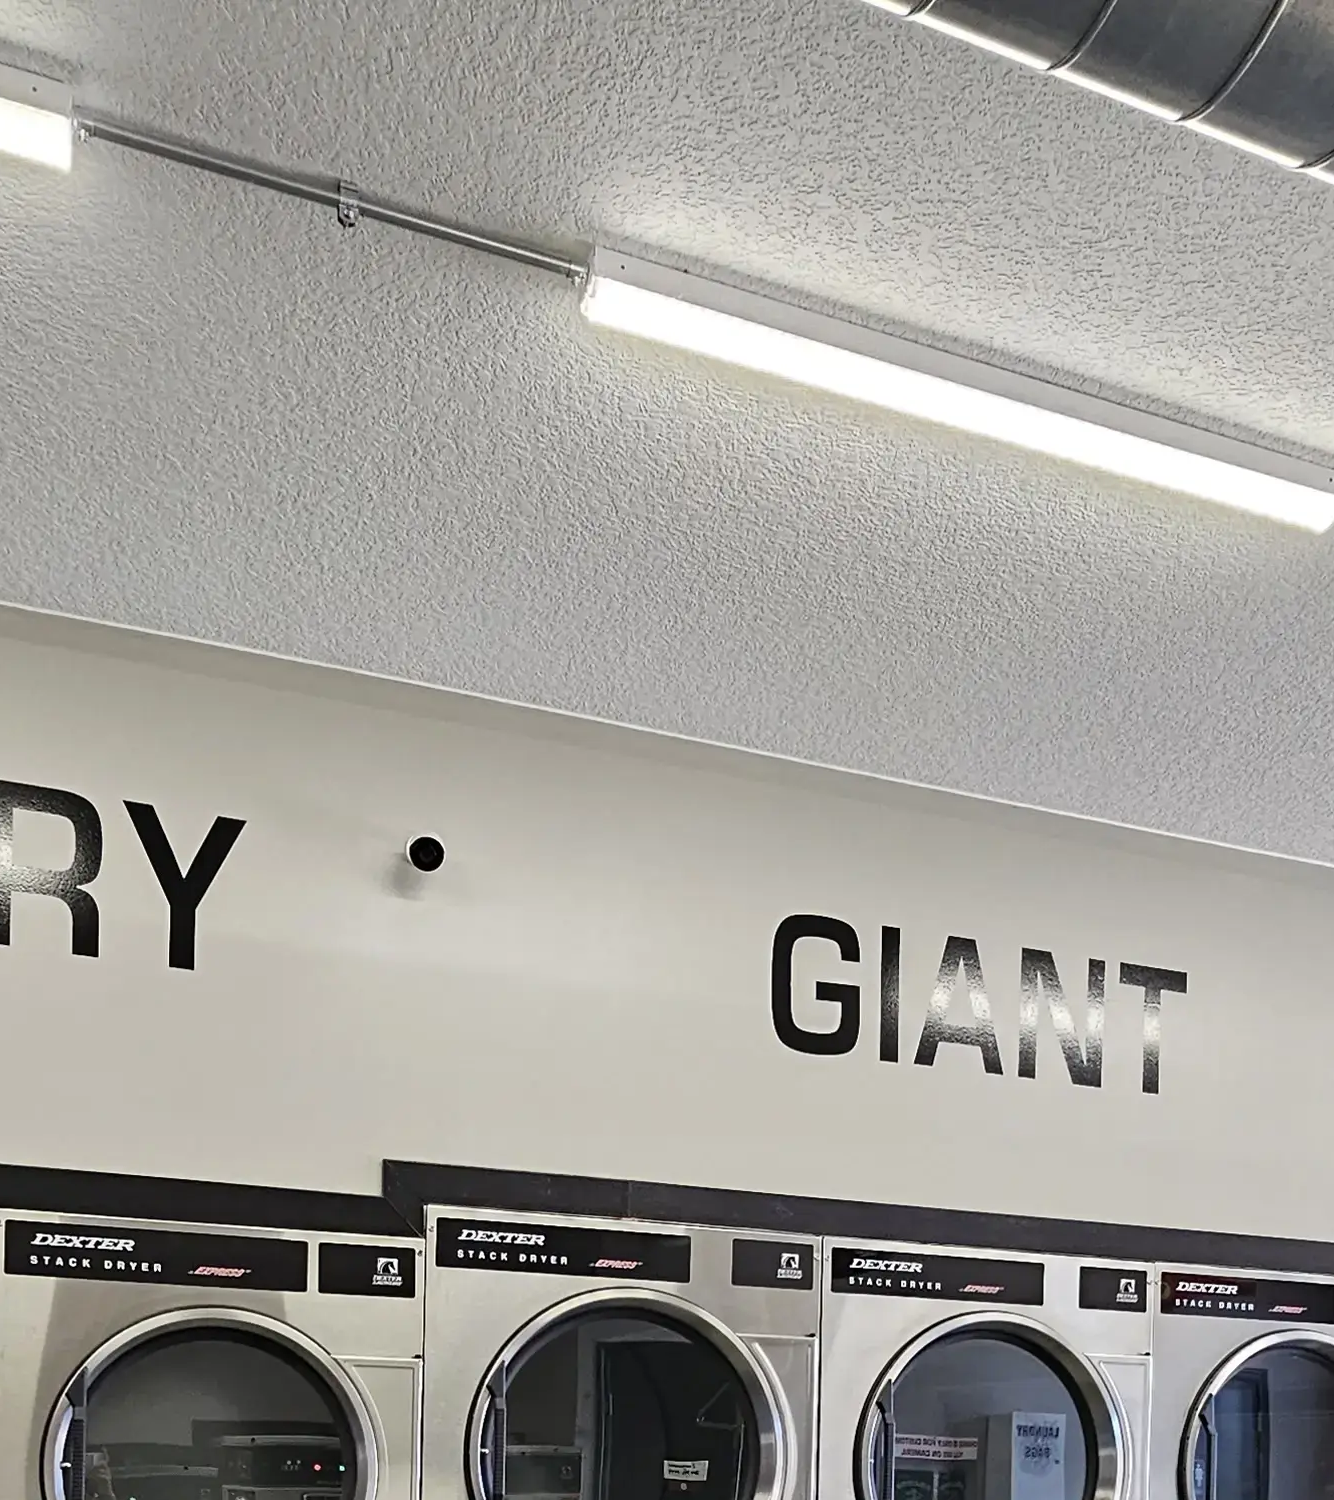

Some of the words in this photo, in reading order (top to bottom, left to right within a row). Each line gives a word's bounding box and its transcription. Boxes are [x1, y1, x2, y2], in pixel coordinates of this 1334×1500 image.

[770, 913, 1188, 1095] GIANT
[30, 1232, 136, 1251] DEXTER
[458, 1228, 546, 1246] DEXTER
[29, 1255, 91, 1268] STACK
[103, 1259, 162, 1273] DRYER
[457, 1248, 508, 1262] STACK
[518, 1253, 568, 1266] DRYER
[849, 1257, 924, 1273] DEXTER
[848, 1276, 892, 1288] STACK
[900, 1280, 942, 1291] DRYER
[1175, 1281, 1239, 1295] DEXTER
